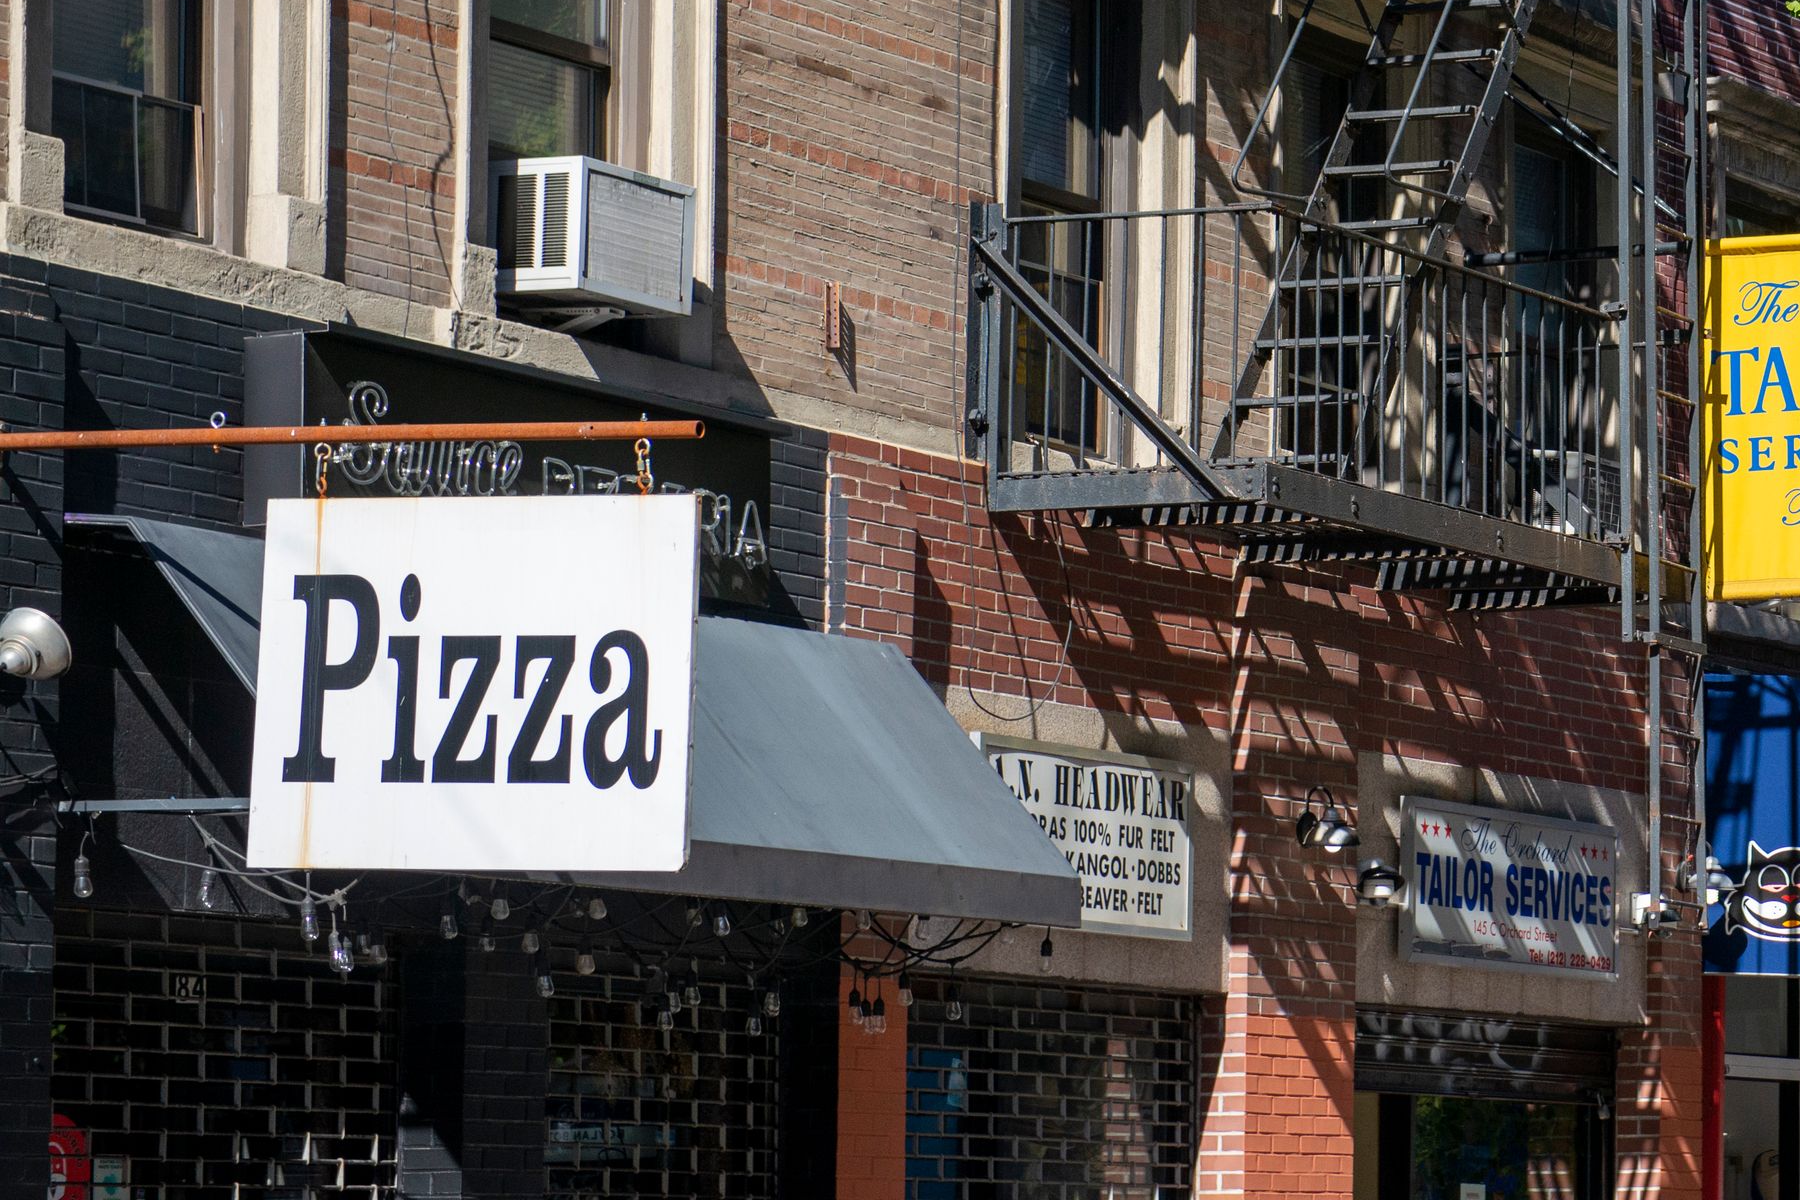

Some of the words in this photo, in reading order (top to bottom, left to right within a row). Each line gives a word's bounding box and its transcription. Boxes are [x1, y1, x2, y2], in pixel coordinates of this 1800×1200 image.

[1733, 280, 1800, 326] The
[543, 456, 768, 566] PRIA
[282, 573, 663, 790] Pizza
[1054, 763, 1185, 821] HEADWEAR
[1073, 819, 1111, 847] 100%
[1118, 824, 1144, 849] FUR
[1150, 828, 1175, 853] FELT
[1461, 816, 1498, 855] The
[1503, 821, 1573, 865] Orchard
[1416, 852, 1494, 913] TAILOR
[1505, 863, 1612, 927] SERVICES
[1473, 919, 1488, 936] 145
[1489, 921, 1497, 937] C
[1499, 921, 1532, 941] Orchard
[1534, 927, 1558, 943] Street
[1529, 949, 1544, 966] Tel:
[1546, 950, 1567, 968] (212)
[1570, 954, 1612, 971] 228-0429
